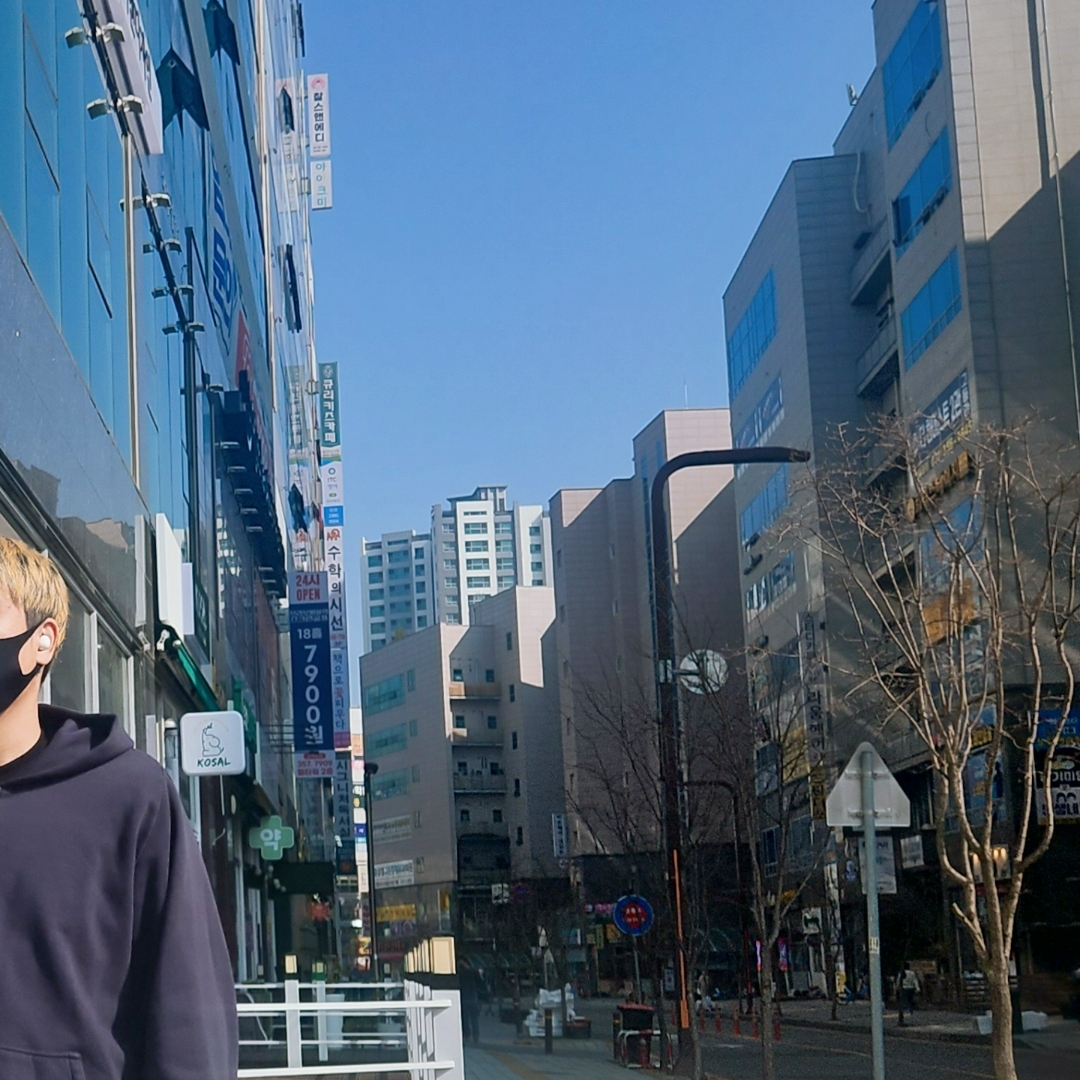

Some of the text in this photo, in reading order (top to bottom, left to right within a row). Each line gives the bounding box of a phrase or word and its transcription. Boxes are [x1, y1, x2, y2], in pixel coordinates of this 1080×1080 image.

[296, 588, 320, 601] OPEN
[197, 757, 231, 768] KOSAL
[260, 829, 281, 851] 약
